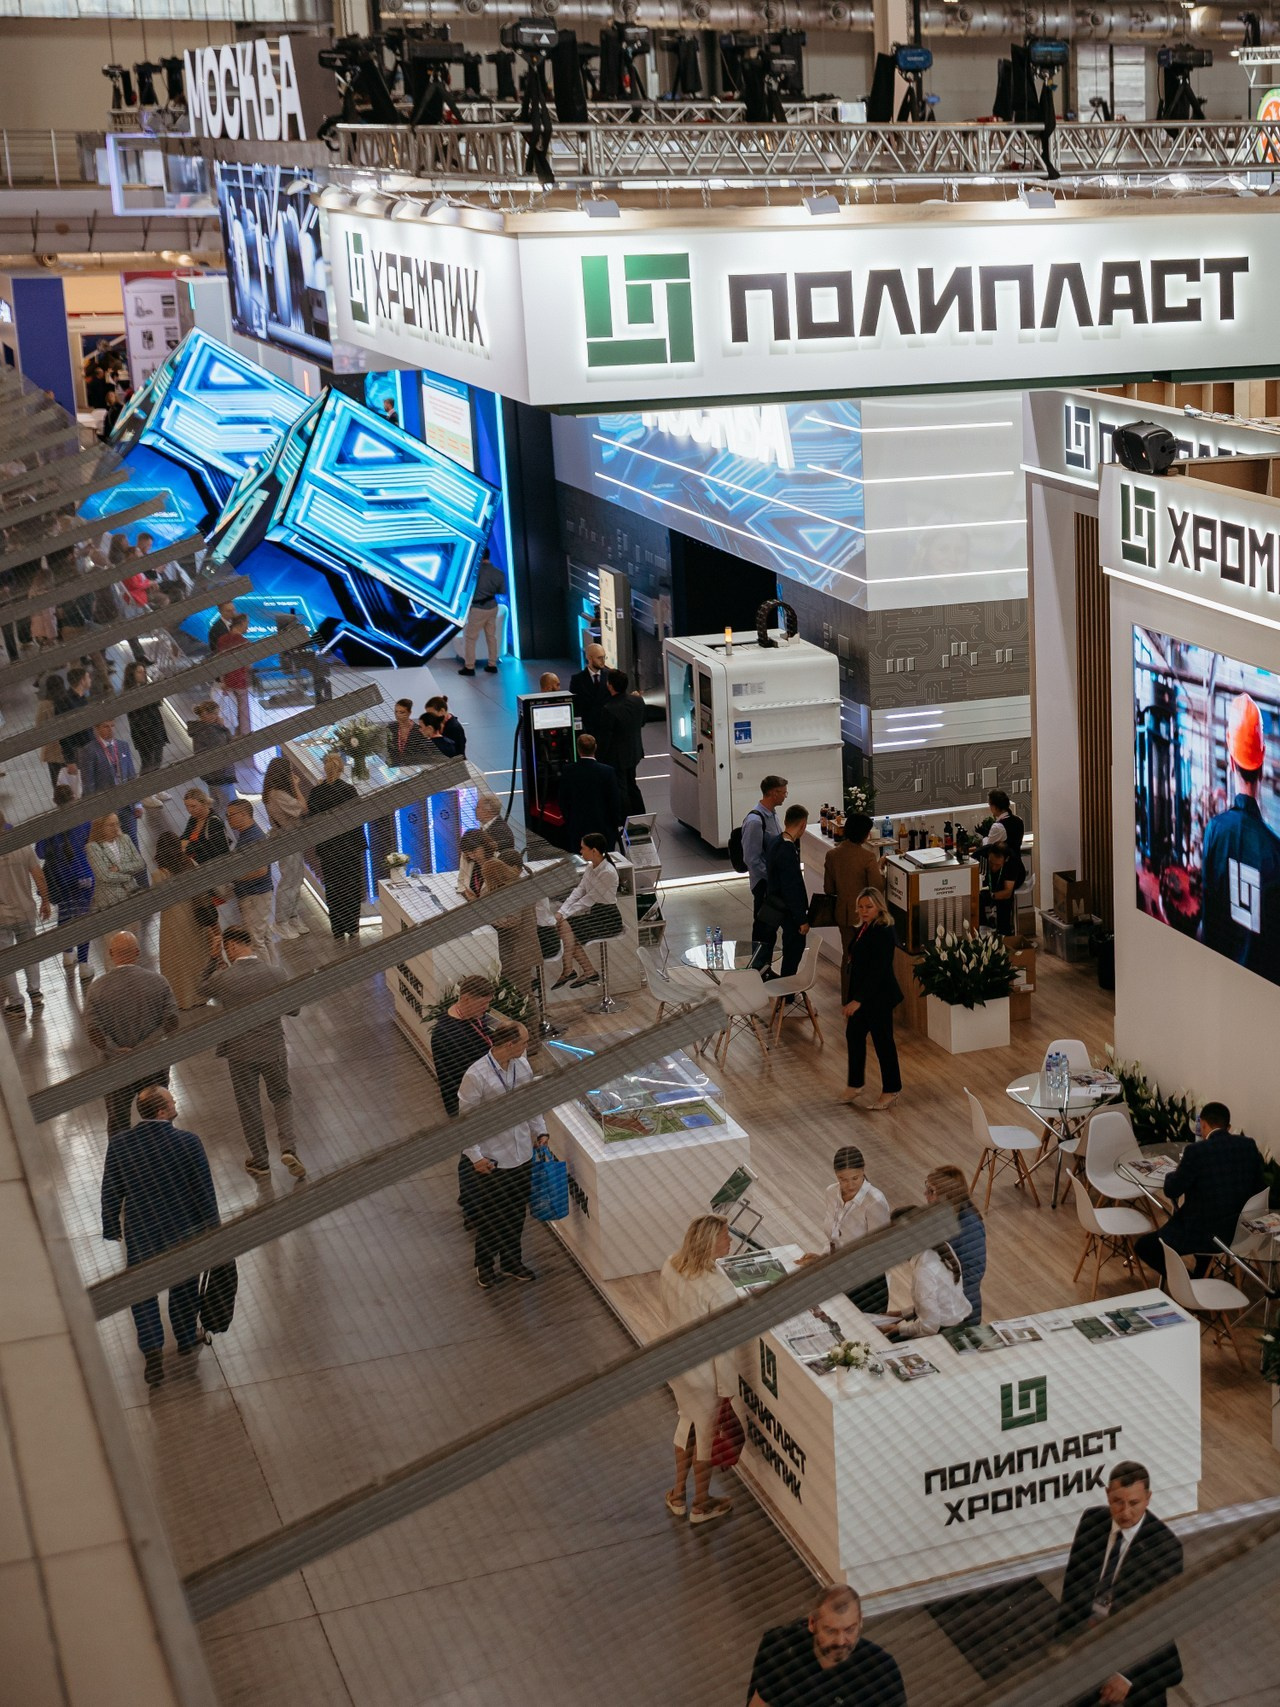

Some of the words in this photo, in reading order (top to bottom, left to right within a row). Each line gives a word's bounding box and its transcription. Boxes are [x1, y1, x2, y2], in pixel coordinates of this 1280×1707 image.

[184, 35, 307, 142] МОСКВА
[371, 250, 485, 347] ХРОМПИК
[728, 256, 1249, 343] ПОЛИПЛАСТ
[924, 1425, 1122, 1495] ПОЛИПЛАСТ
[944, 1463, 1106, 1526] ХРОМПИК
